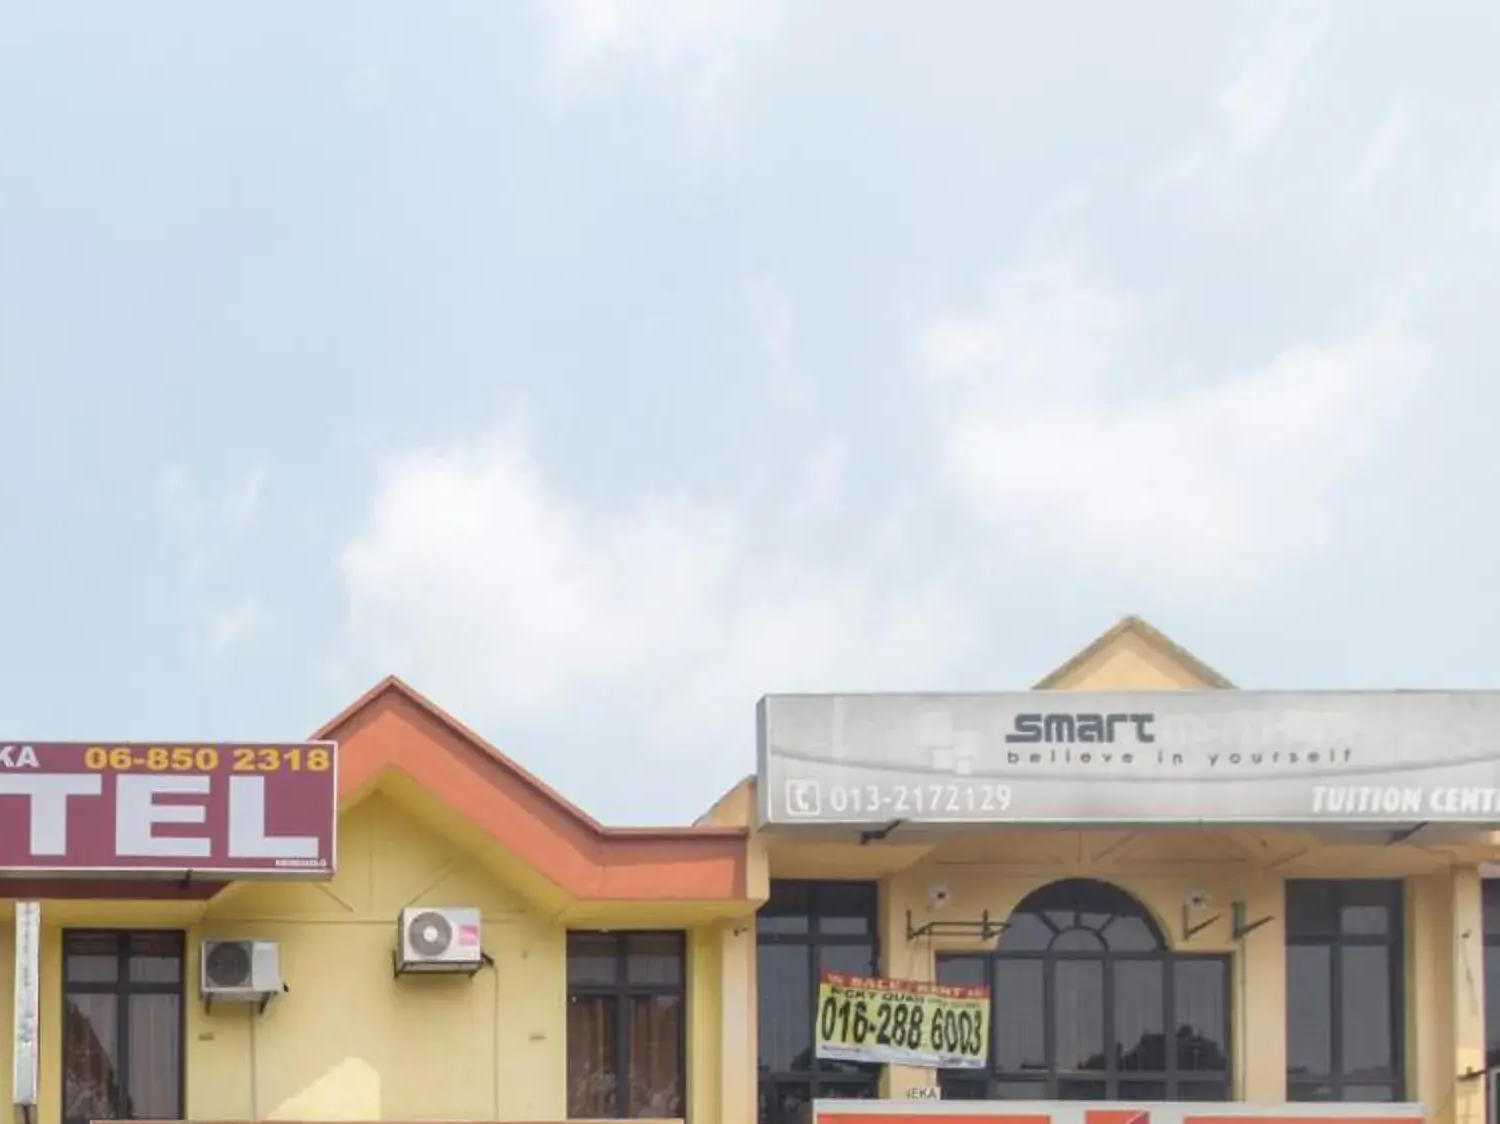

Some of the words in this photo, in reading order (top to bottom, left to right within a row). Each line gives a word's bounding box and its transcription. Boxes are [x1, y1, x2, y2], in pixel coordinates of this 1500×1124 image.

[1005, 713, 1155, 743] smart
[85, 747, 218, 771] 06-850
[232, 748, 330, 771] 2318
[1007, 748, 1134, 764] believe
[1157, 748, 1184, 765] in
[1208, 747, 1353, 767] yourself
[830, 783, 1013, 812] 013-2172129
[1312, 785, 1422, 813] TUITION
[821, 996, 924, 1050] 016-288
[931, 1007, 983, 1056] 6003
